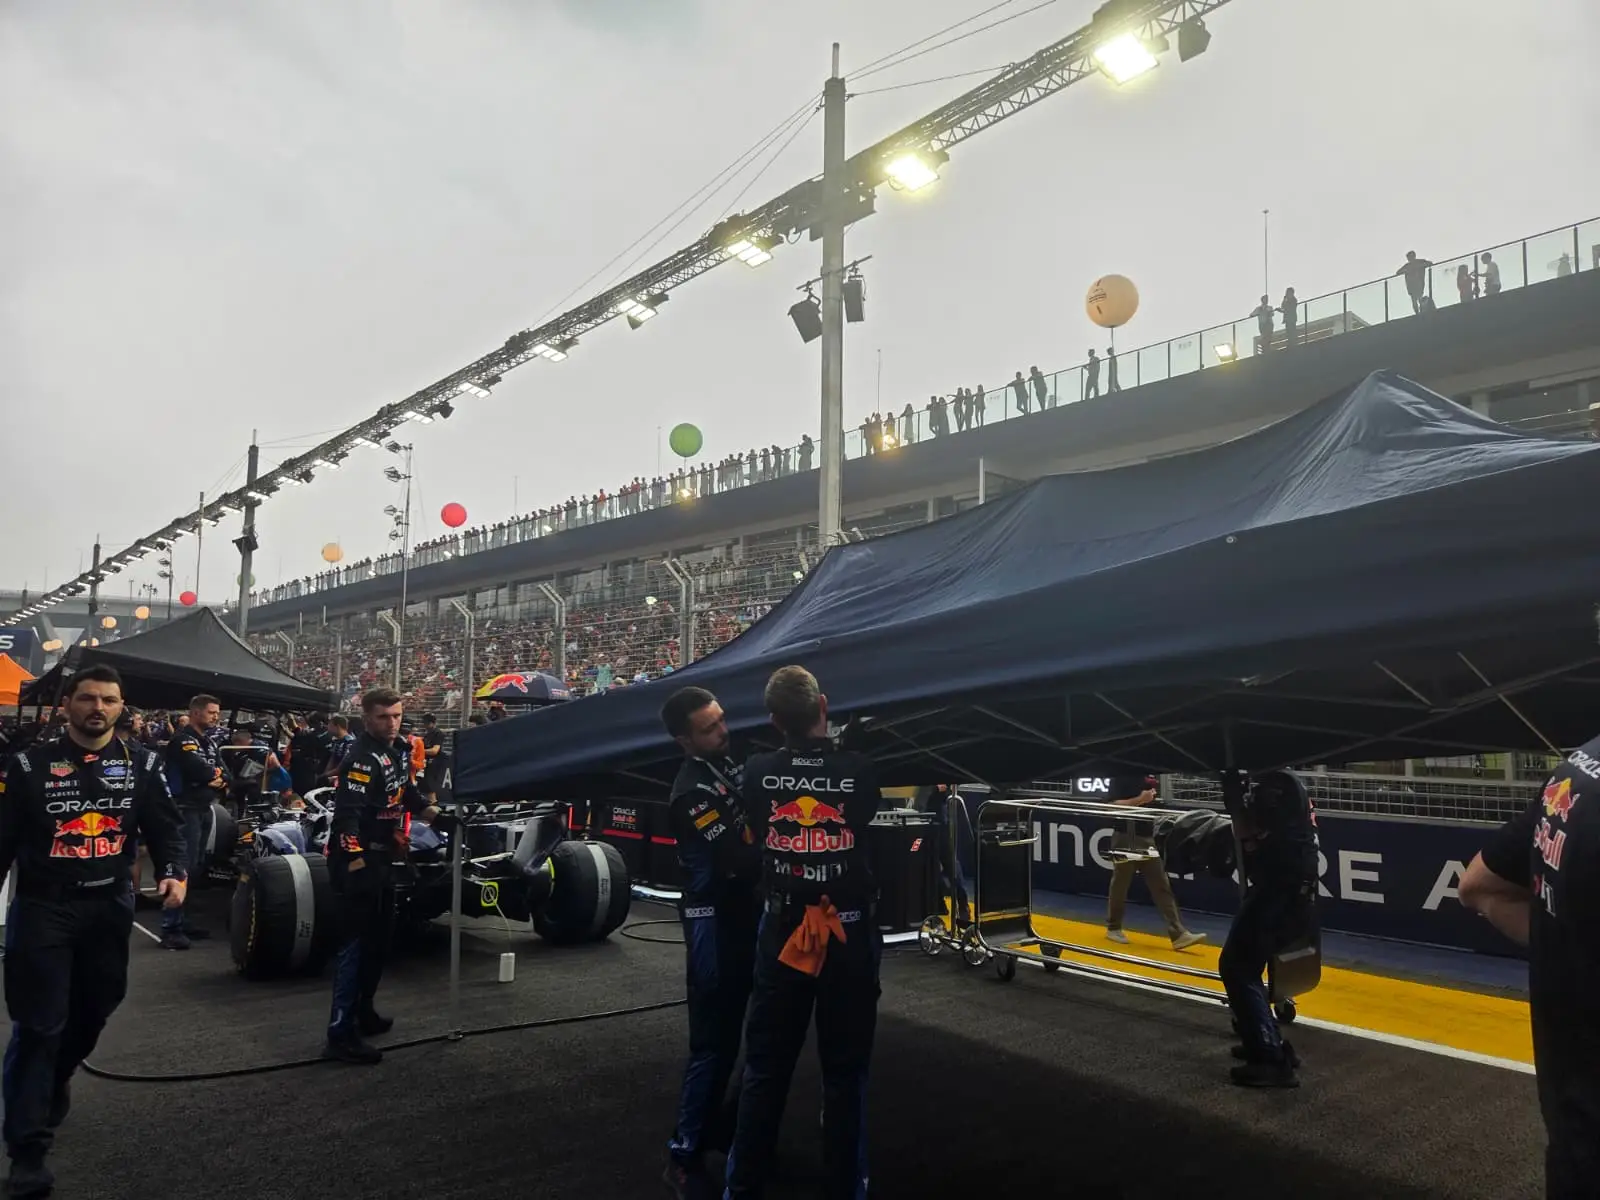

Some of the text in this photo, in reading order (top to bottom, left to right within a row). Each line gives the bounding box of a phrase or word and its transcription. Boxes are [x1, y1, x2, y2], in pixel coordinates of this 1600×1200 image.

[348, 782, 366, 794] VISA
[762, 775, 855, 793] ORACLE
[46, 797, 133, 814] ORACLE
[703, 822, 728, 843] VISA
[766, 826, 855, 853] Red Bull
[50, 834, 127, 859] Red Bull
[836, 910, 862, 922] arco
